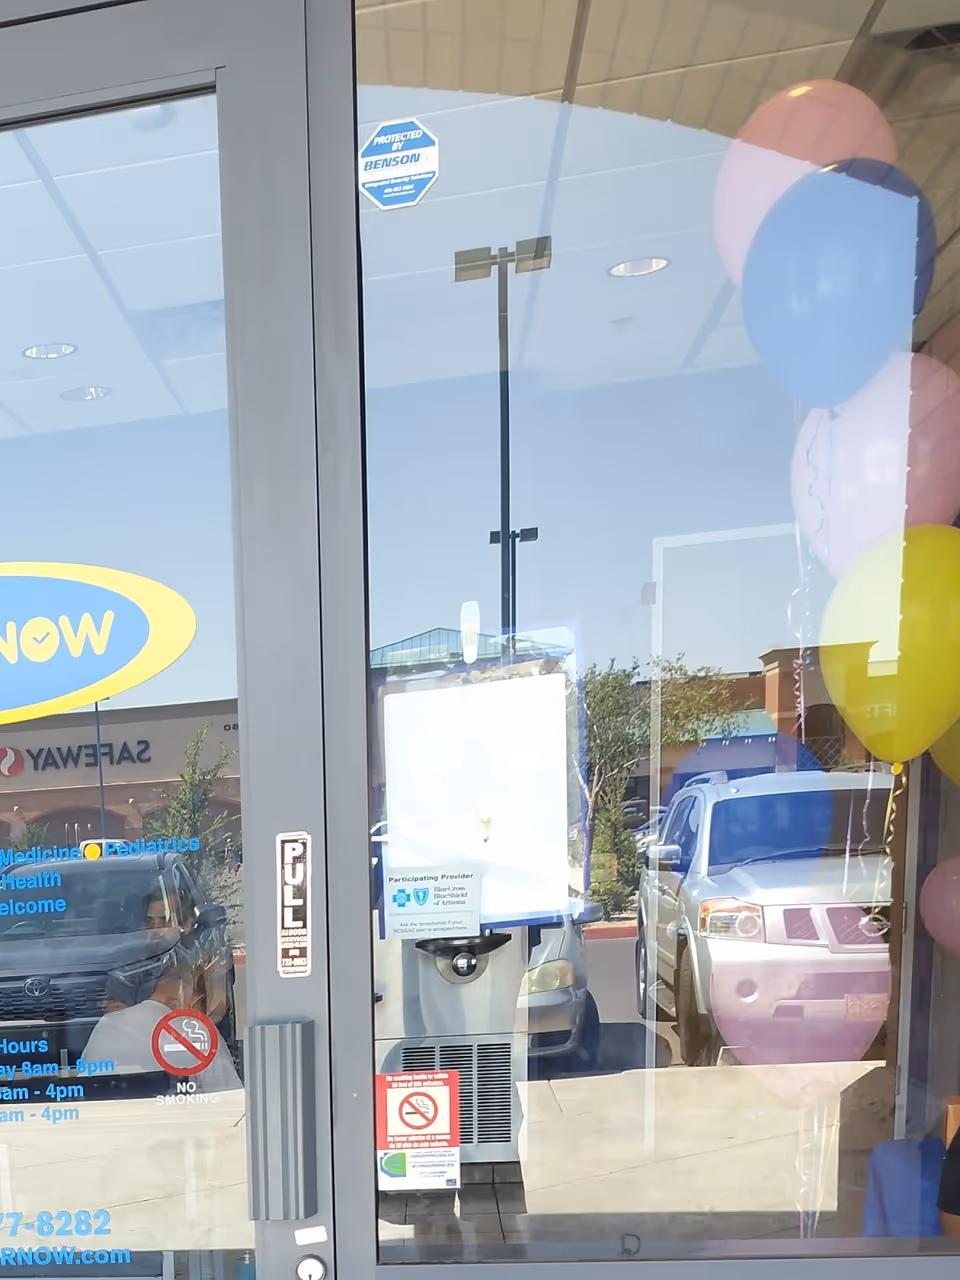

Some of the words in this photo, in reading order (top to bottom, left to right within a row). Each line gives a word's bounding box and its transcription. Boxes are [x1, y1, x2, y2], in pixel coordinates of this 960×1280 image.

[373, 129, 423, 146] PROTECTED
[391, 142, 404, 151] BY
[363, 152, 421, 171] BENSON
[0, 845, 81, 866] Medicine
[105, 836, 200, 857] Pediatrics
[2, 871, 62, 890] Health
[283, 842, 304, 928] PULL
[388, 875, 439, 883] Participating
[21, 1061, 59, 1076] 8am
[76, 1058, 115, 1077] 8pm
[45, 1083, 84, 1101] 4pm
[176, 1081, 196, 1093] NO
[156, 1094, 219, 1106] SMOKING
[41, 1106, 79, 1124] 4pm
